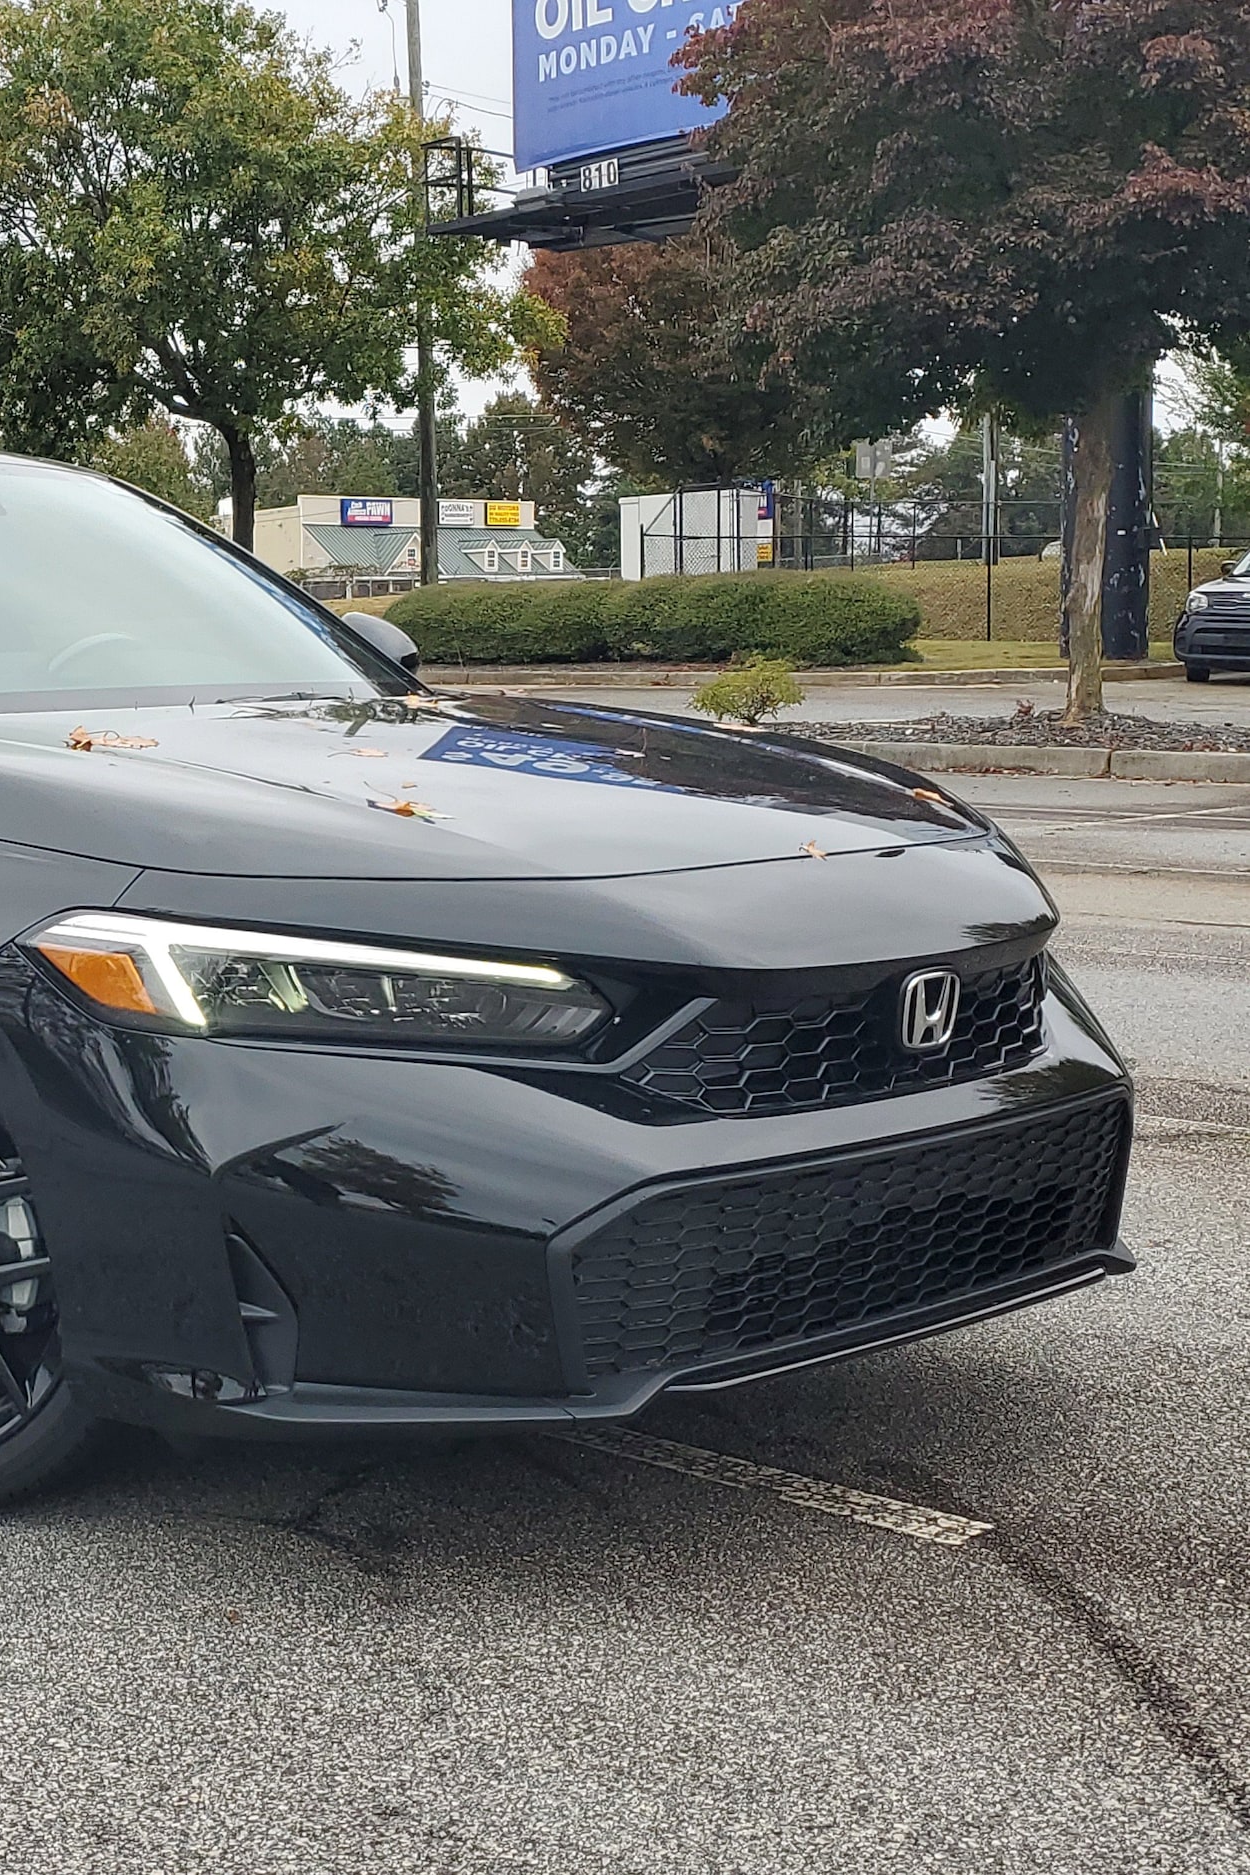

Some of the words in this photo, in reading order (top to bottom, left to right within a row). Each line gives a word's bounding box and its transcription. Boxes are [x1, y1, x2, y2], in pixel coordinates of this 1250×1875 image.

[538, 23, 655, 83] MONDAY
[582, 160, 618, 191] 810
[366, 501, 390, 516] PAWN
